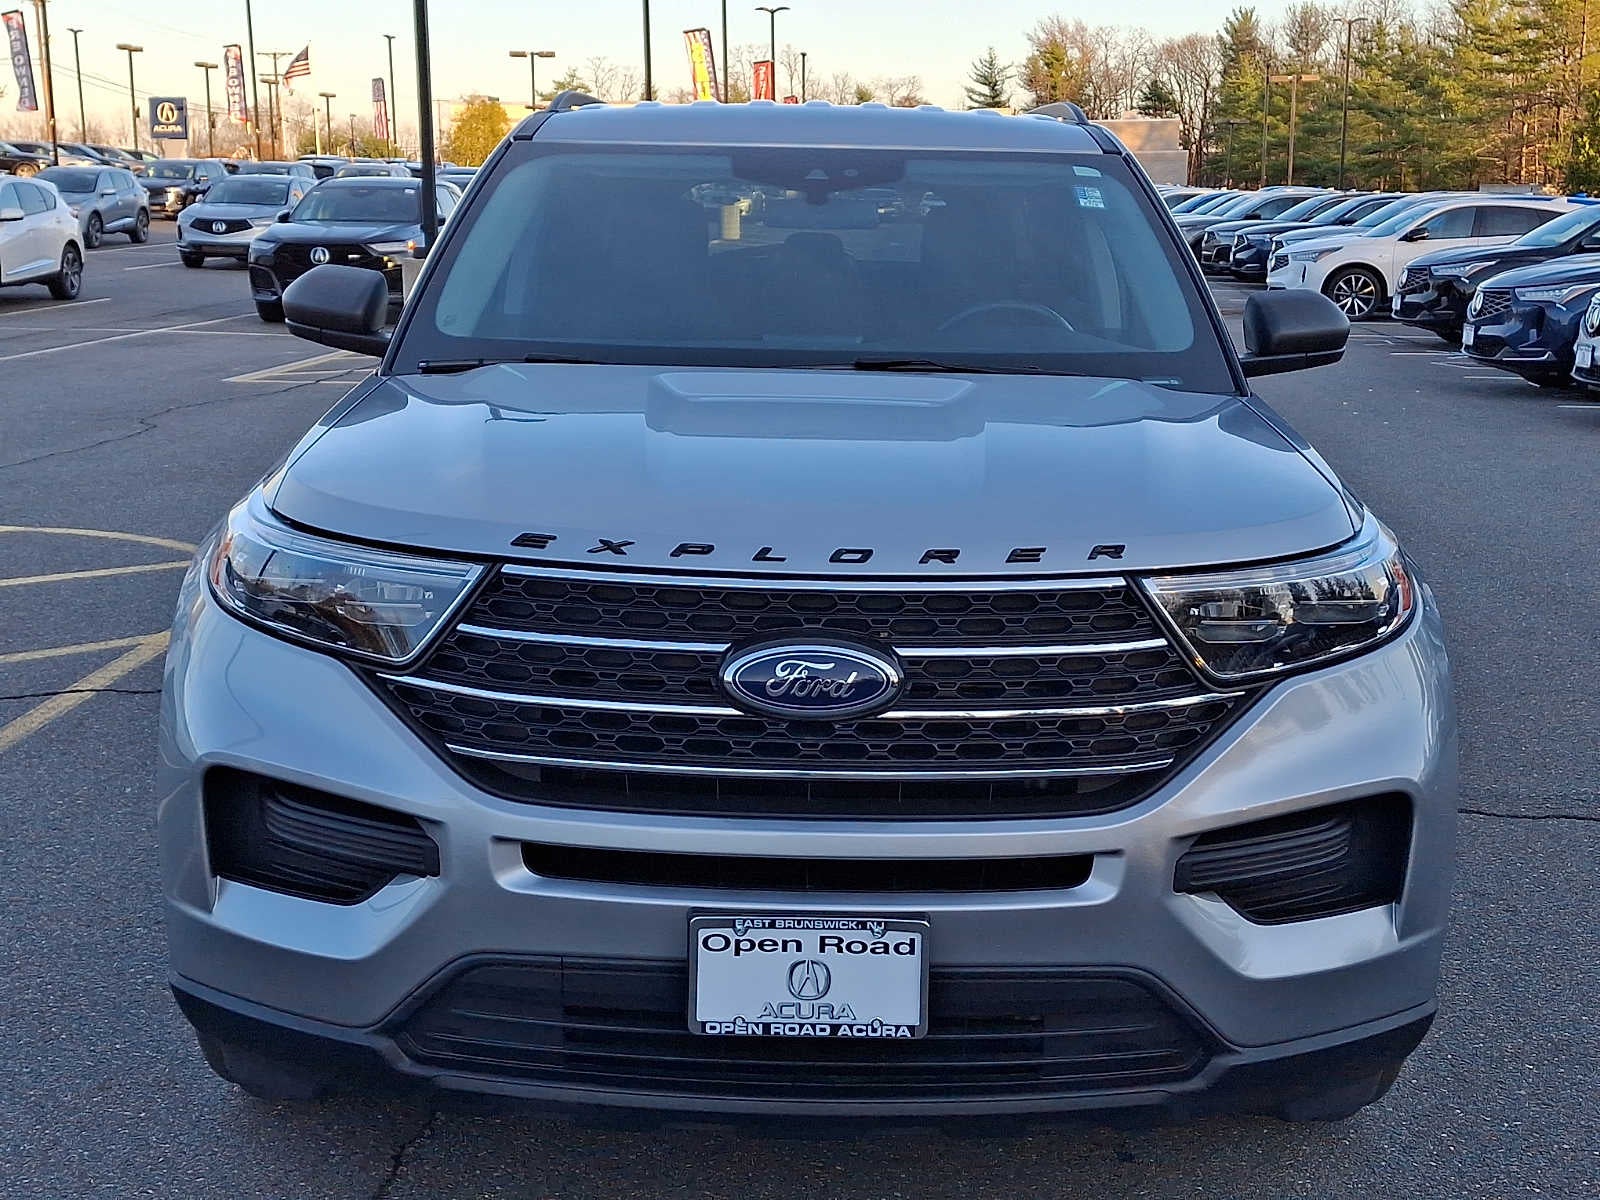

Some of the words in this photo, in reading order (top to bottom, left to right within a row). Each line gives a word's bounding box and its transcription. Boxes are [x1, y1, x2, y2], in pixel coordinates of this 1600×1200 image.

[153, 125, 182, 133] ACURA
[510, 532, 1126, 564] EXPLORER
[765, 659, 858, 698] Ford
[736, 919, 771, 929] EAST
[867, 921, 885, 931] NJ
[701, 933, 803, 956] Open
[818, 935, 915, 956] Road
[758, 1002, 856, 1020] ACURA
[705, 1022, 762, 1034] OPEN
[770, 1023, 830, 1036] ROAD
[837, 1024, 912, 1037] ACURA
